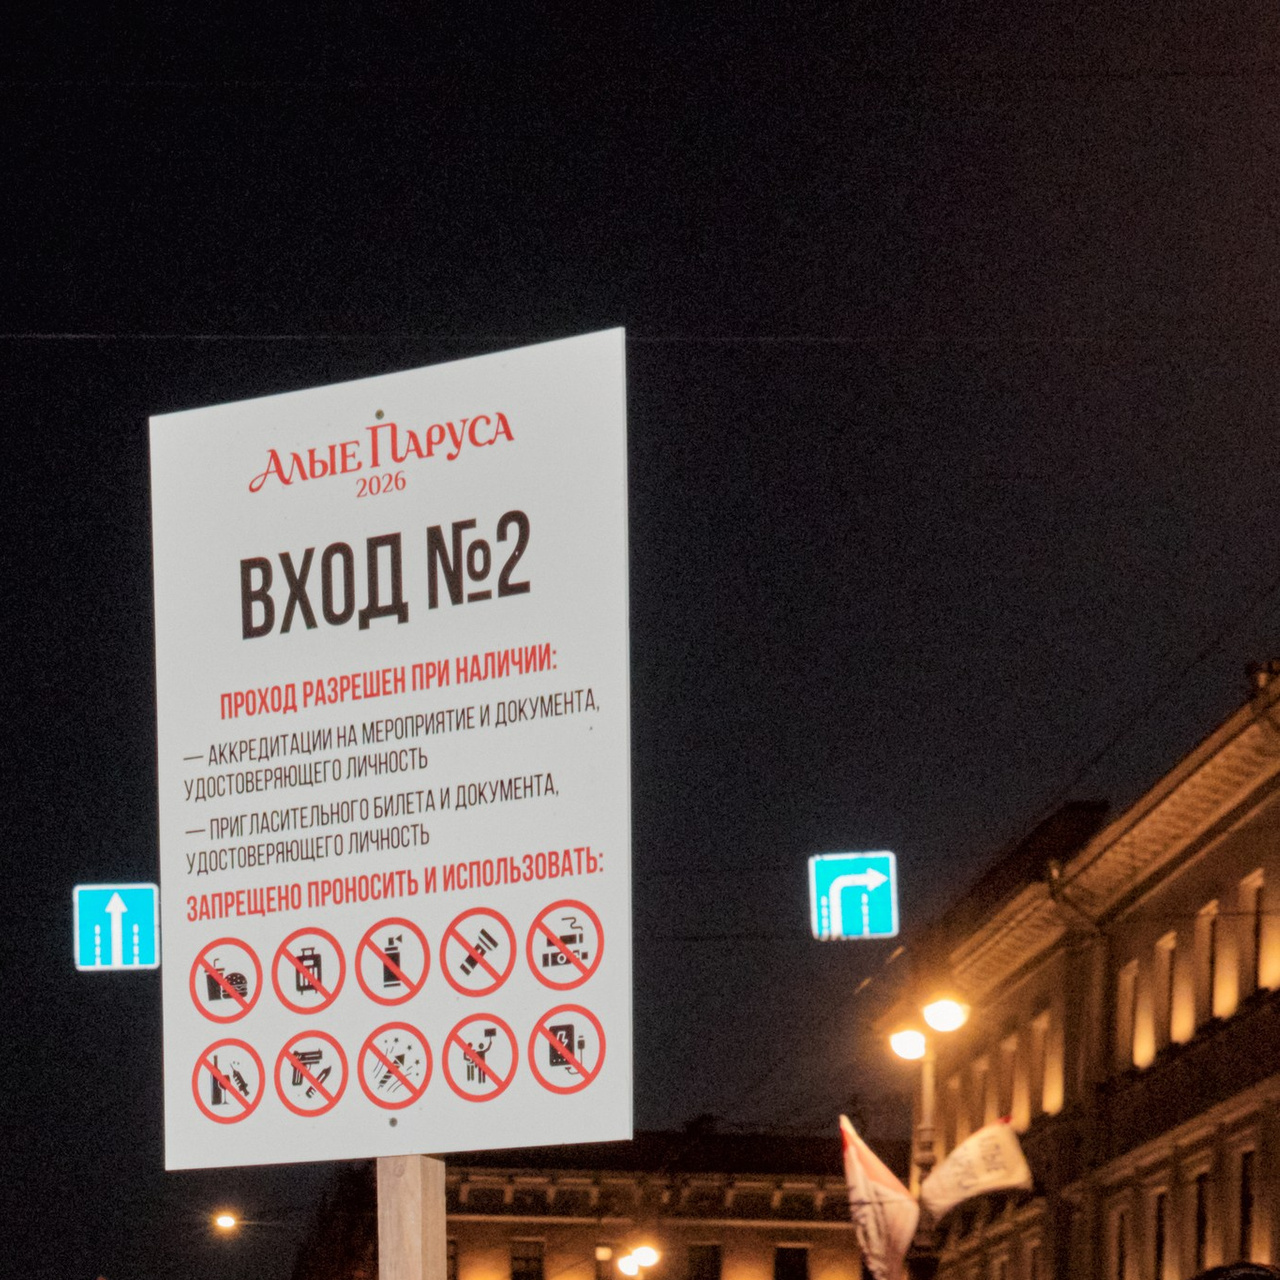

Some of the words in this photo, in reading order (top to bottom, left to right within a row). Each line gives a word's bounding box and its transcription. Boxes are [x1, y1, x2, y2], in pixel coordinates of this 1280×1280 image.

[356, 471, 407, 498] 2026
[240, 531, 409, 641] ВХОД
[426, 509, 531, 610] №2
[220, 682, 298, 720] ПРОХОД
[302, 666, 406, 708] РАЗРЕШЕН
[411, 658, 450, 692] ПРИ
[455, 642, 557, 685] НАЛИЧИИ:
[208, 728, 333, 766] АККРЕДИТАЦИИ
[336, 724, 358, 748] НА
[362, 706, 475, 745] МЕРОПРИЯТИЕ
[480, 704, 490, 727] И
[495, 688, 600, 727] ДОКУМЕНТА,
[184, 758, 342, 803] УДОСТОВЕРЯЮЩЕГО
[346, 747, 428, 779] ЛИЧНОСТЬ
[210, 798, 369, 841] ПРИГЛАСИТЕЛЬНОГО
[373, 789, 436, 819] БИЛЕТА
[440, 787, 450, 810] И
[454, 772, 559, 811] ДОКУМЕНТА,
[186, 833, 344, 876] УДОСТОВЕРЯЮЩЕГО
[348, 823, 430, 855] ЛИЧНОСТЬ
[186, 883, 302, 923] ЗАПРЕЩЕНО
[307, 869, 419, 908] ПРОНОСИТЬ
[424, 866, 437, 894] И
[442, 846, 603, 892] ИСПОЛЬЗОВАТЬ:
